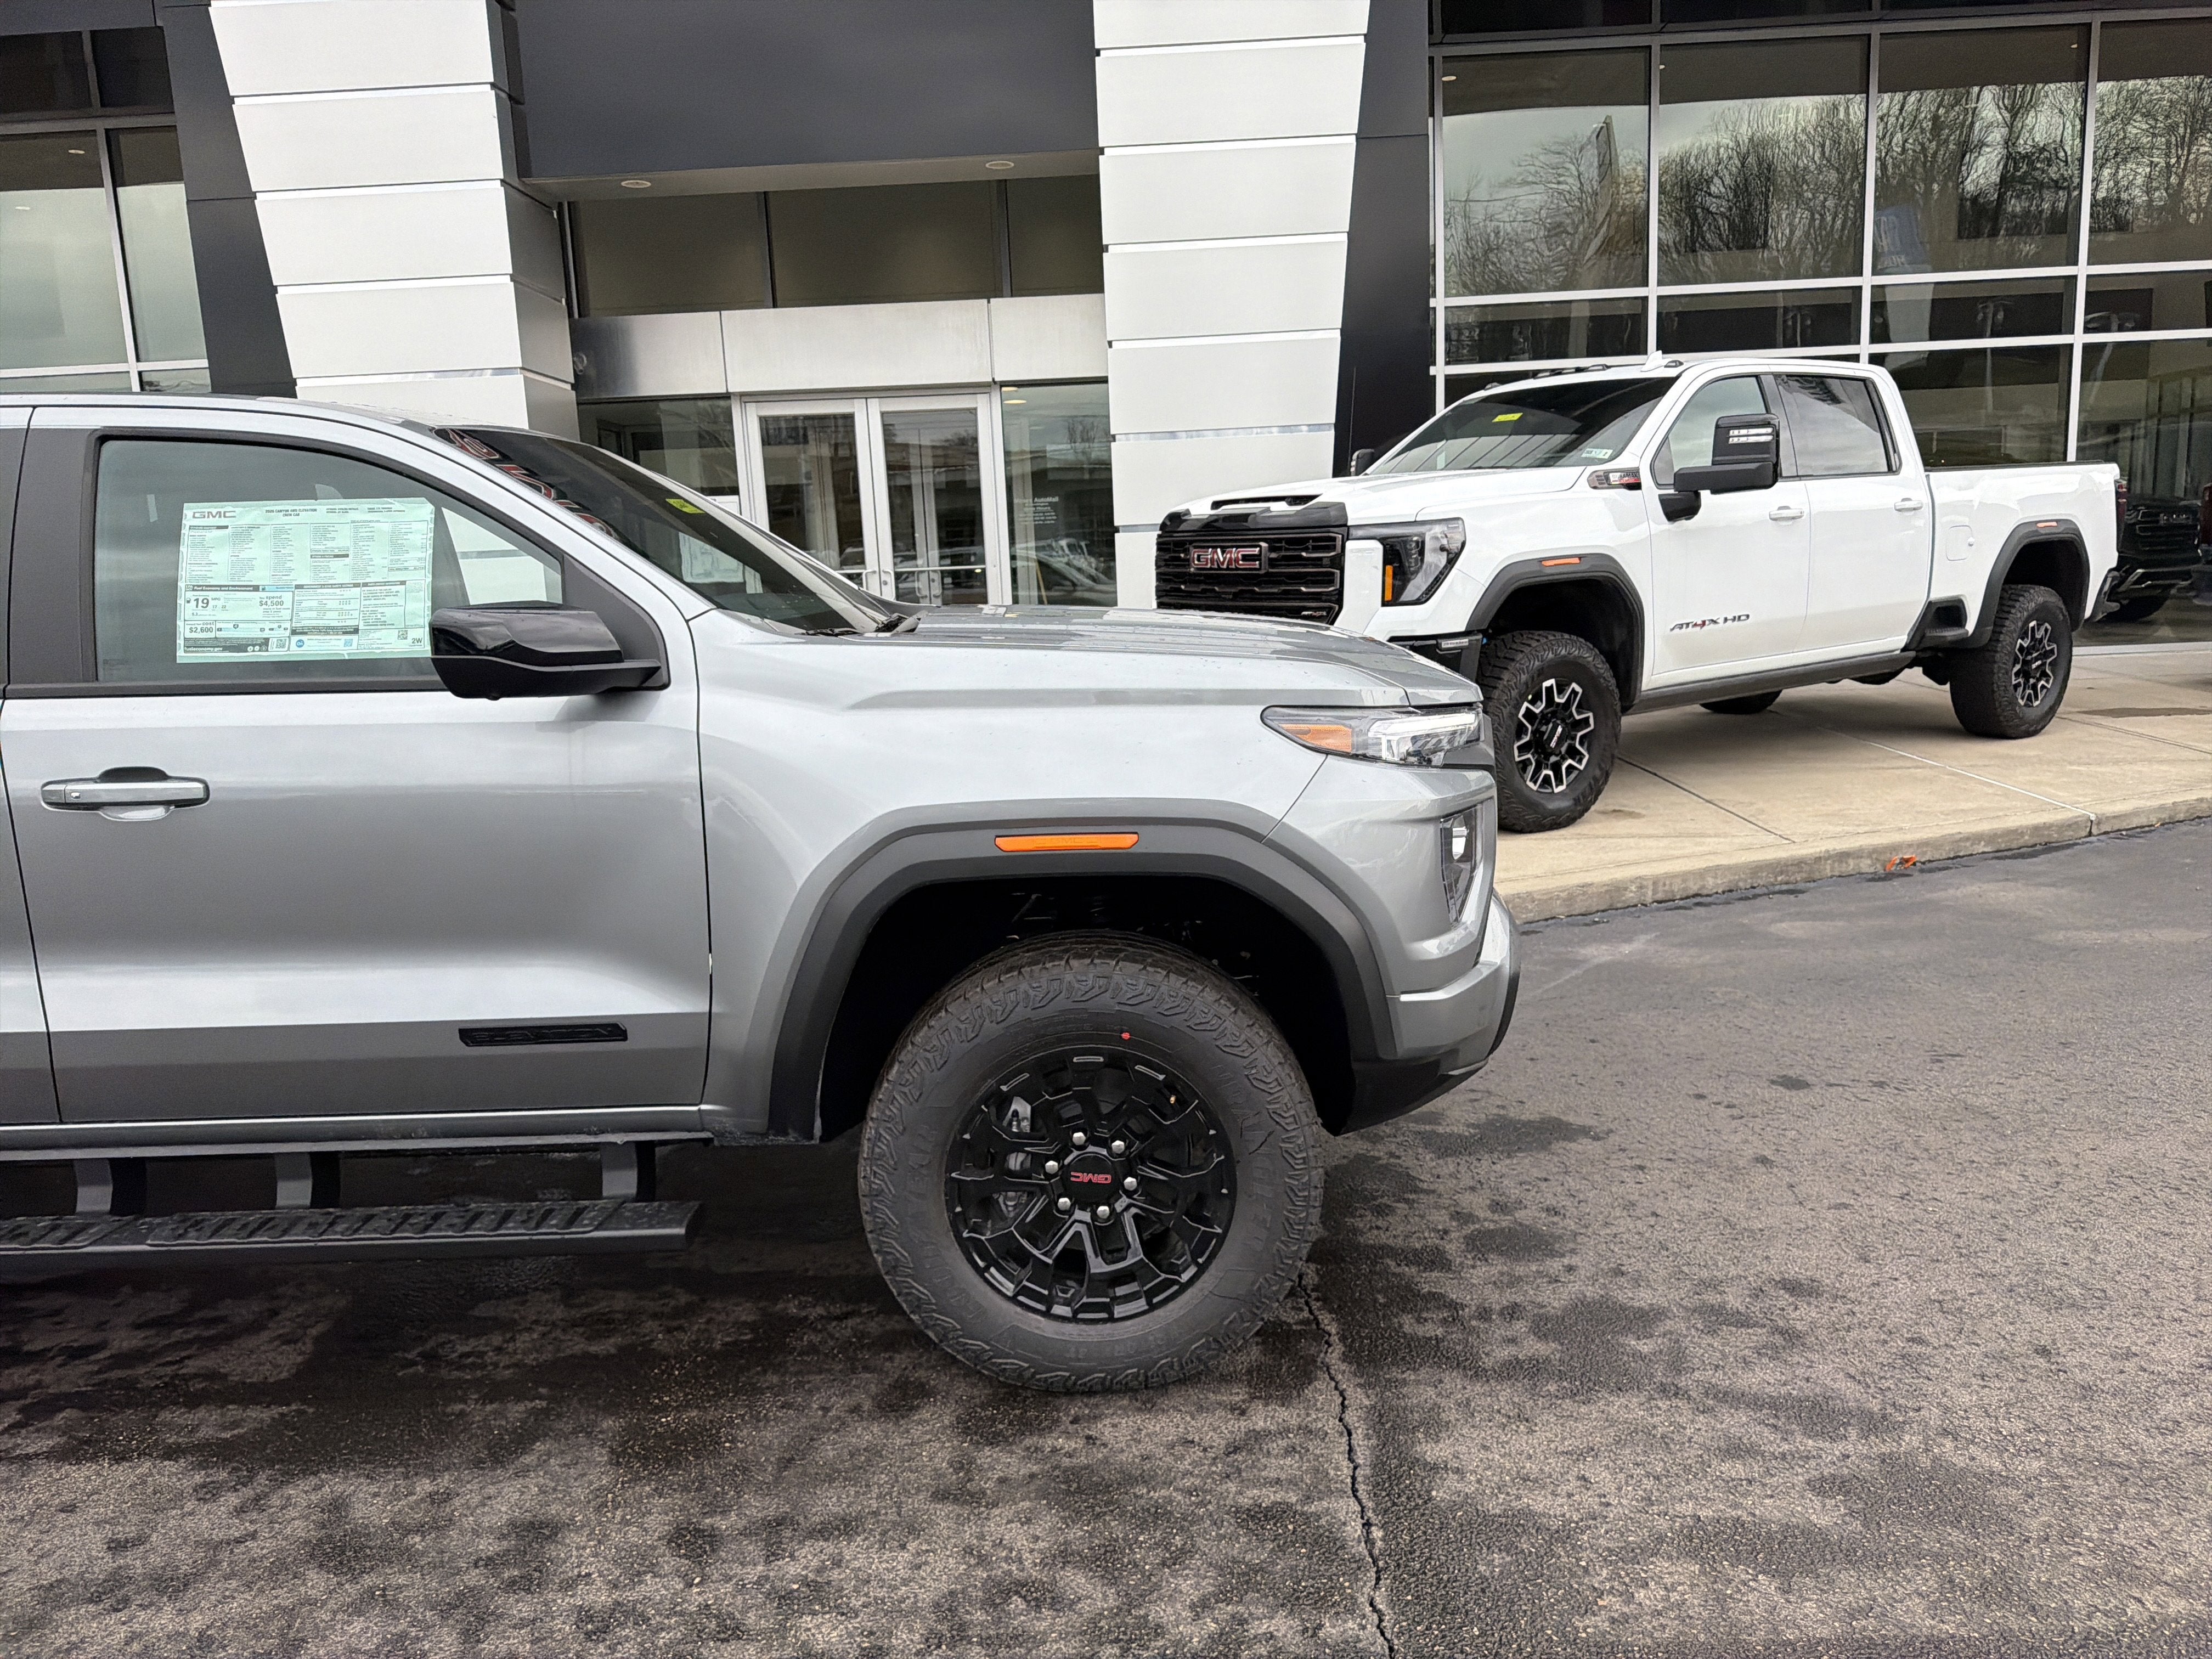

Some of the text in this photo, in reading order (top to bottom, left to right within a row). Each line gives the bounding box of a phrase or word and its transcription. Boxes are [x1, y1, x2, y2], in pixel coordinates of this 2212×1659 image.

[192, 510, 236, 519] GMC
[1191, 547, 1260, 569] GMC
[193, 597, 210, 608] 19
[1669, 614, 1750, 632] AT4X HD
[1070, 1171, 1112, 1184] GMC
